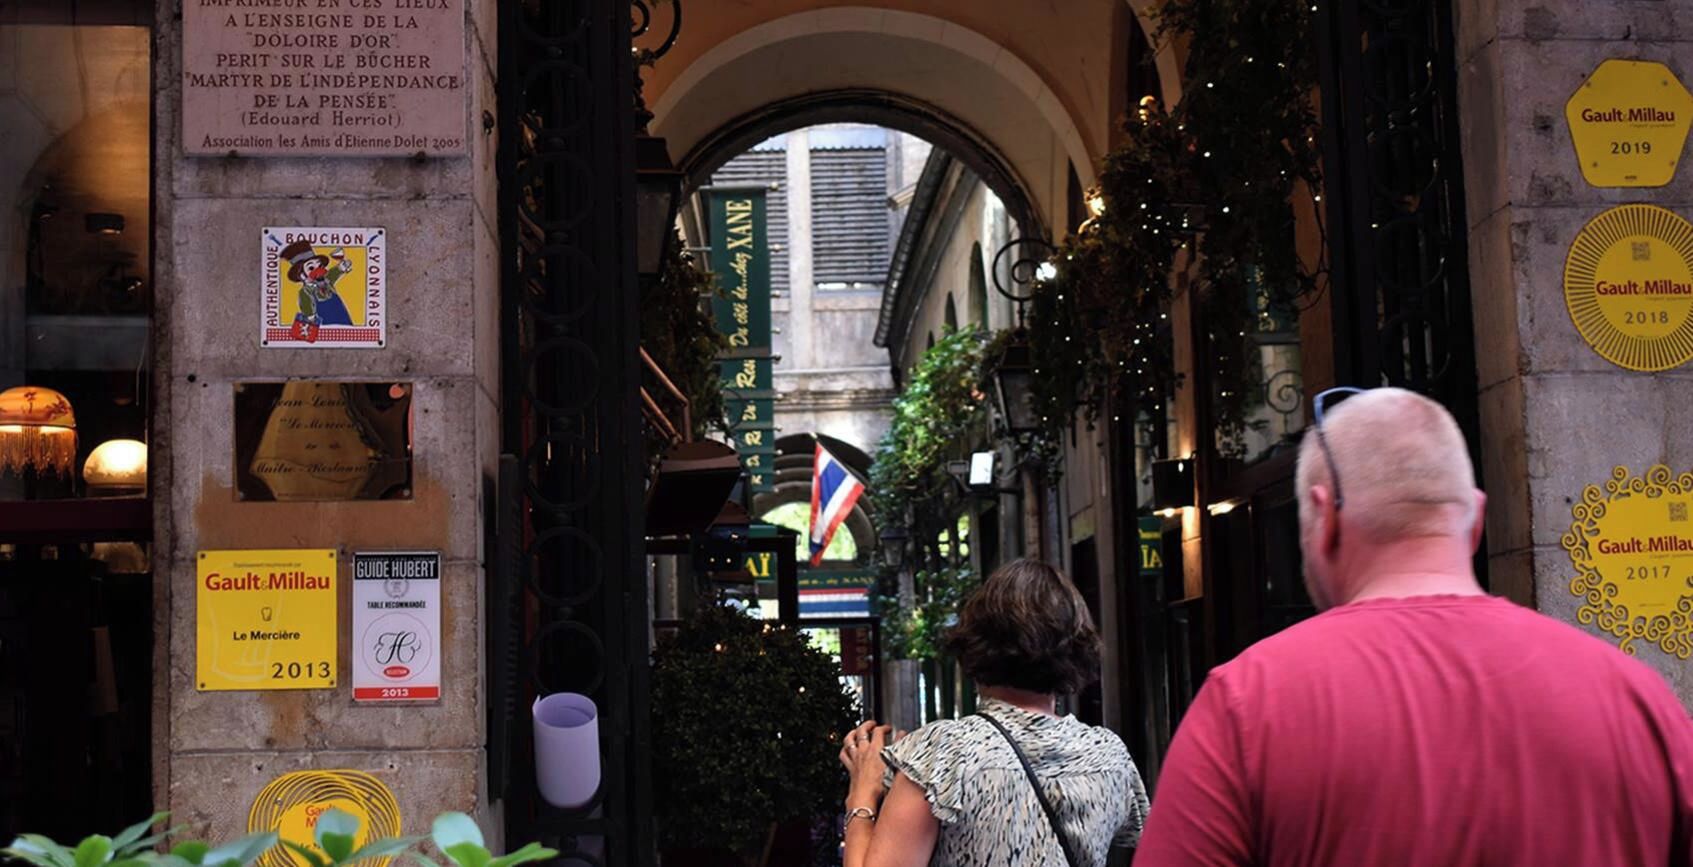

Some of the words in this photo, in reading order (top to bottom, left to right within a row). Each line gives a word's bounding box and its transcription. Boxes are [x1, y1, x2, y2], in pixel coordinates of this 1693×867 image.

[225, 14, 238, 27] A
[244, 12, 353, 28] L'ENSEIGNE
[364, 15, 386, 28] DE
[394, 16, 419, 28] LA
[216, 53, 271, 68] PERIT
[281, 54, 315, 68] SUR
[324, 55, 345, 68] LE
[356, 50, 431, 69] BÛCHER
[270, 74, 292, 88] DE
[254, 94, 278, 108] DE
[286, 94, 309, 108] LA
[241, 111, 320, 128] (Edouard
[332, 110, 402, 129] Herriot)
[202, 133, 273, 149] Association
[279, 134, 296, 148] les
[301, 134, 330, 148] Amis
[394, 134, 428, 149] Dolet
[432, 137, 461, 151] 2005
[1611, 141, 1651, 155] 2019
[726, 199, 753, 249] XANE
[285, 233, 364, 244] BOUCHON
[266, 245, 279, 327] AUTHENTIQUE
[368, 246, 380, 328] LYONNAIS
[1625, 311, 1669, 324] 2018
[356, 560, 389, 578] GUIDE
[391, 560, 436, 577] HUBERT
[1626, 565, 1671, 580] 2017
[367, 601, 384, 609] TABLE
[385, 599, 426, 609] RECOMMANDÉE
[233, 630, 247, 641] Le
[250, 630, 301, 641] Mercière
[271, 661, 331, 679] 2013
[381, 688, 409, 697] 2013
